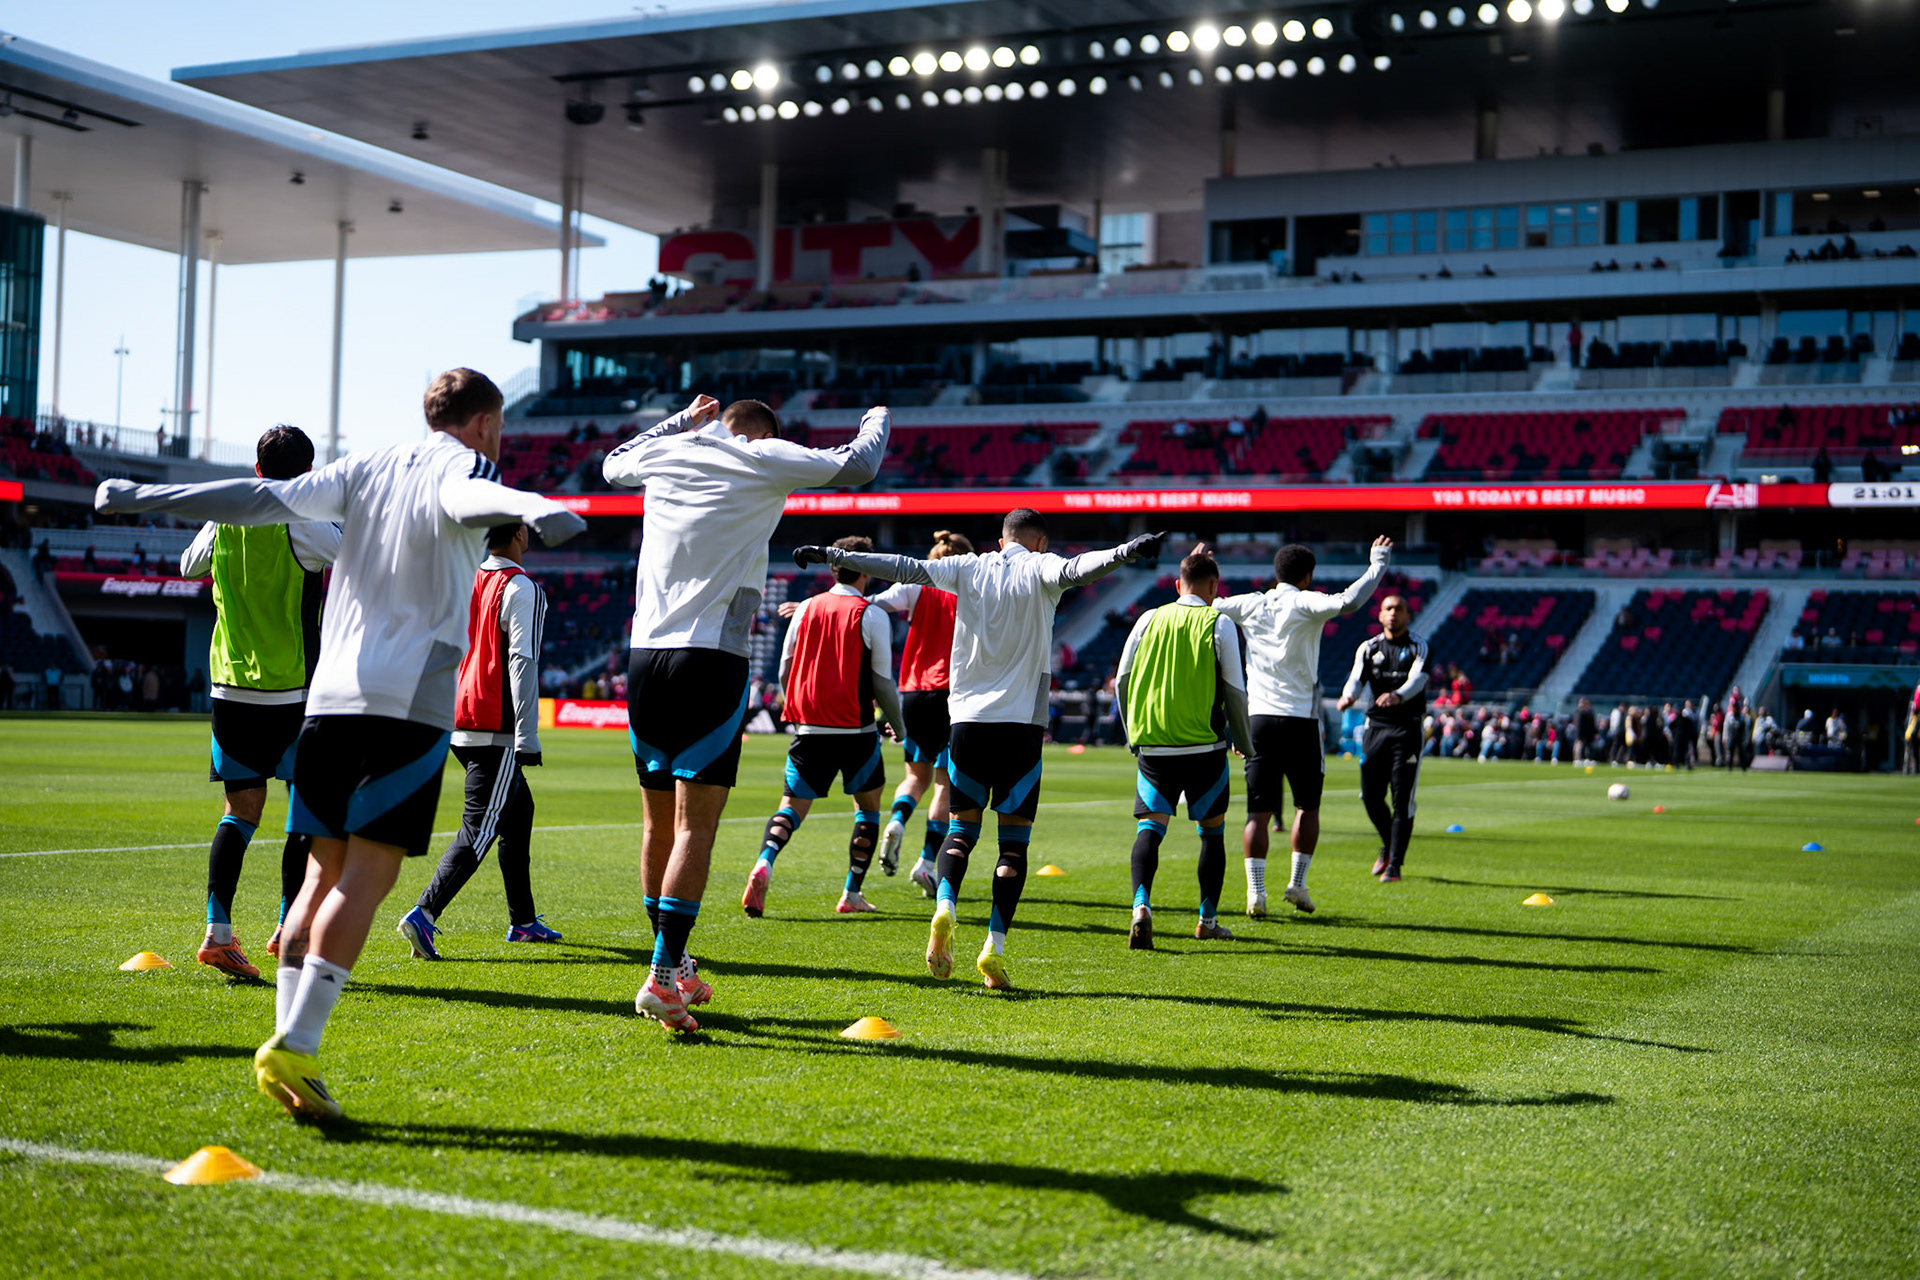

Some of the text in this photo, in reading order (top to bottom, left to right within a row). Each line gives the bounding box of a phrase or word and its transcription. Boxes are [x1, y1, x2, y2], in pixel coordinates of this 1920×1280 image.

[659, 215, 980, 290] CITY
[1094, 493, 1157, 507] TODAY'S
[1159, 492, 1199, 507] BEST
[1201, 492, 1251, 507] MUSIC
[1467, 489, 1538, 504] TODAY'S
[1541, 489, 1585, 504] BEST
[1589, 488, 1645, 504] MUSIC
[1854, 487, 1915, 499] 21:01
[101, 577, 162, 597] Energizer
[558, 702, 629, 727] Energiz
